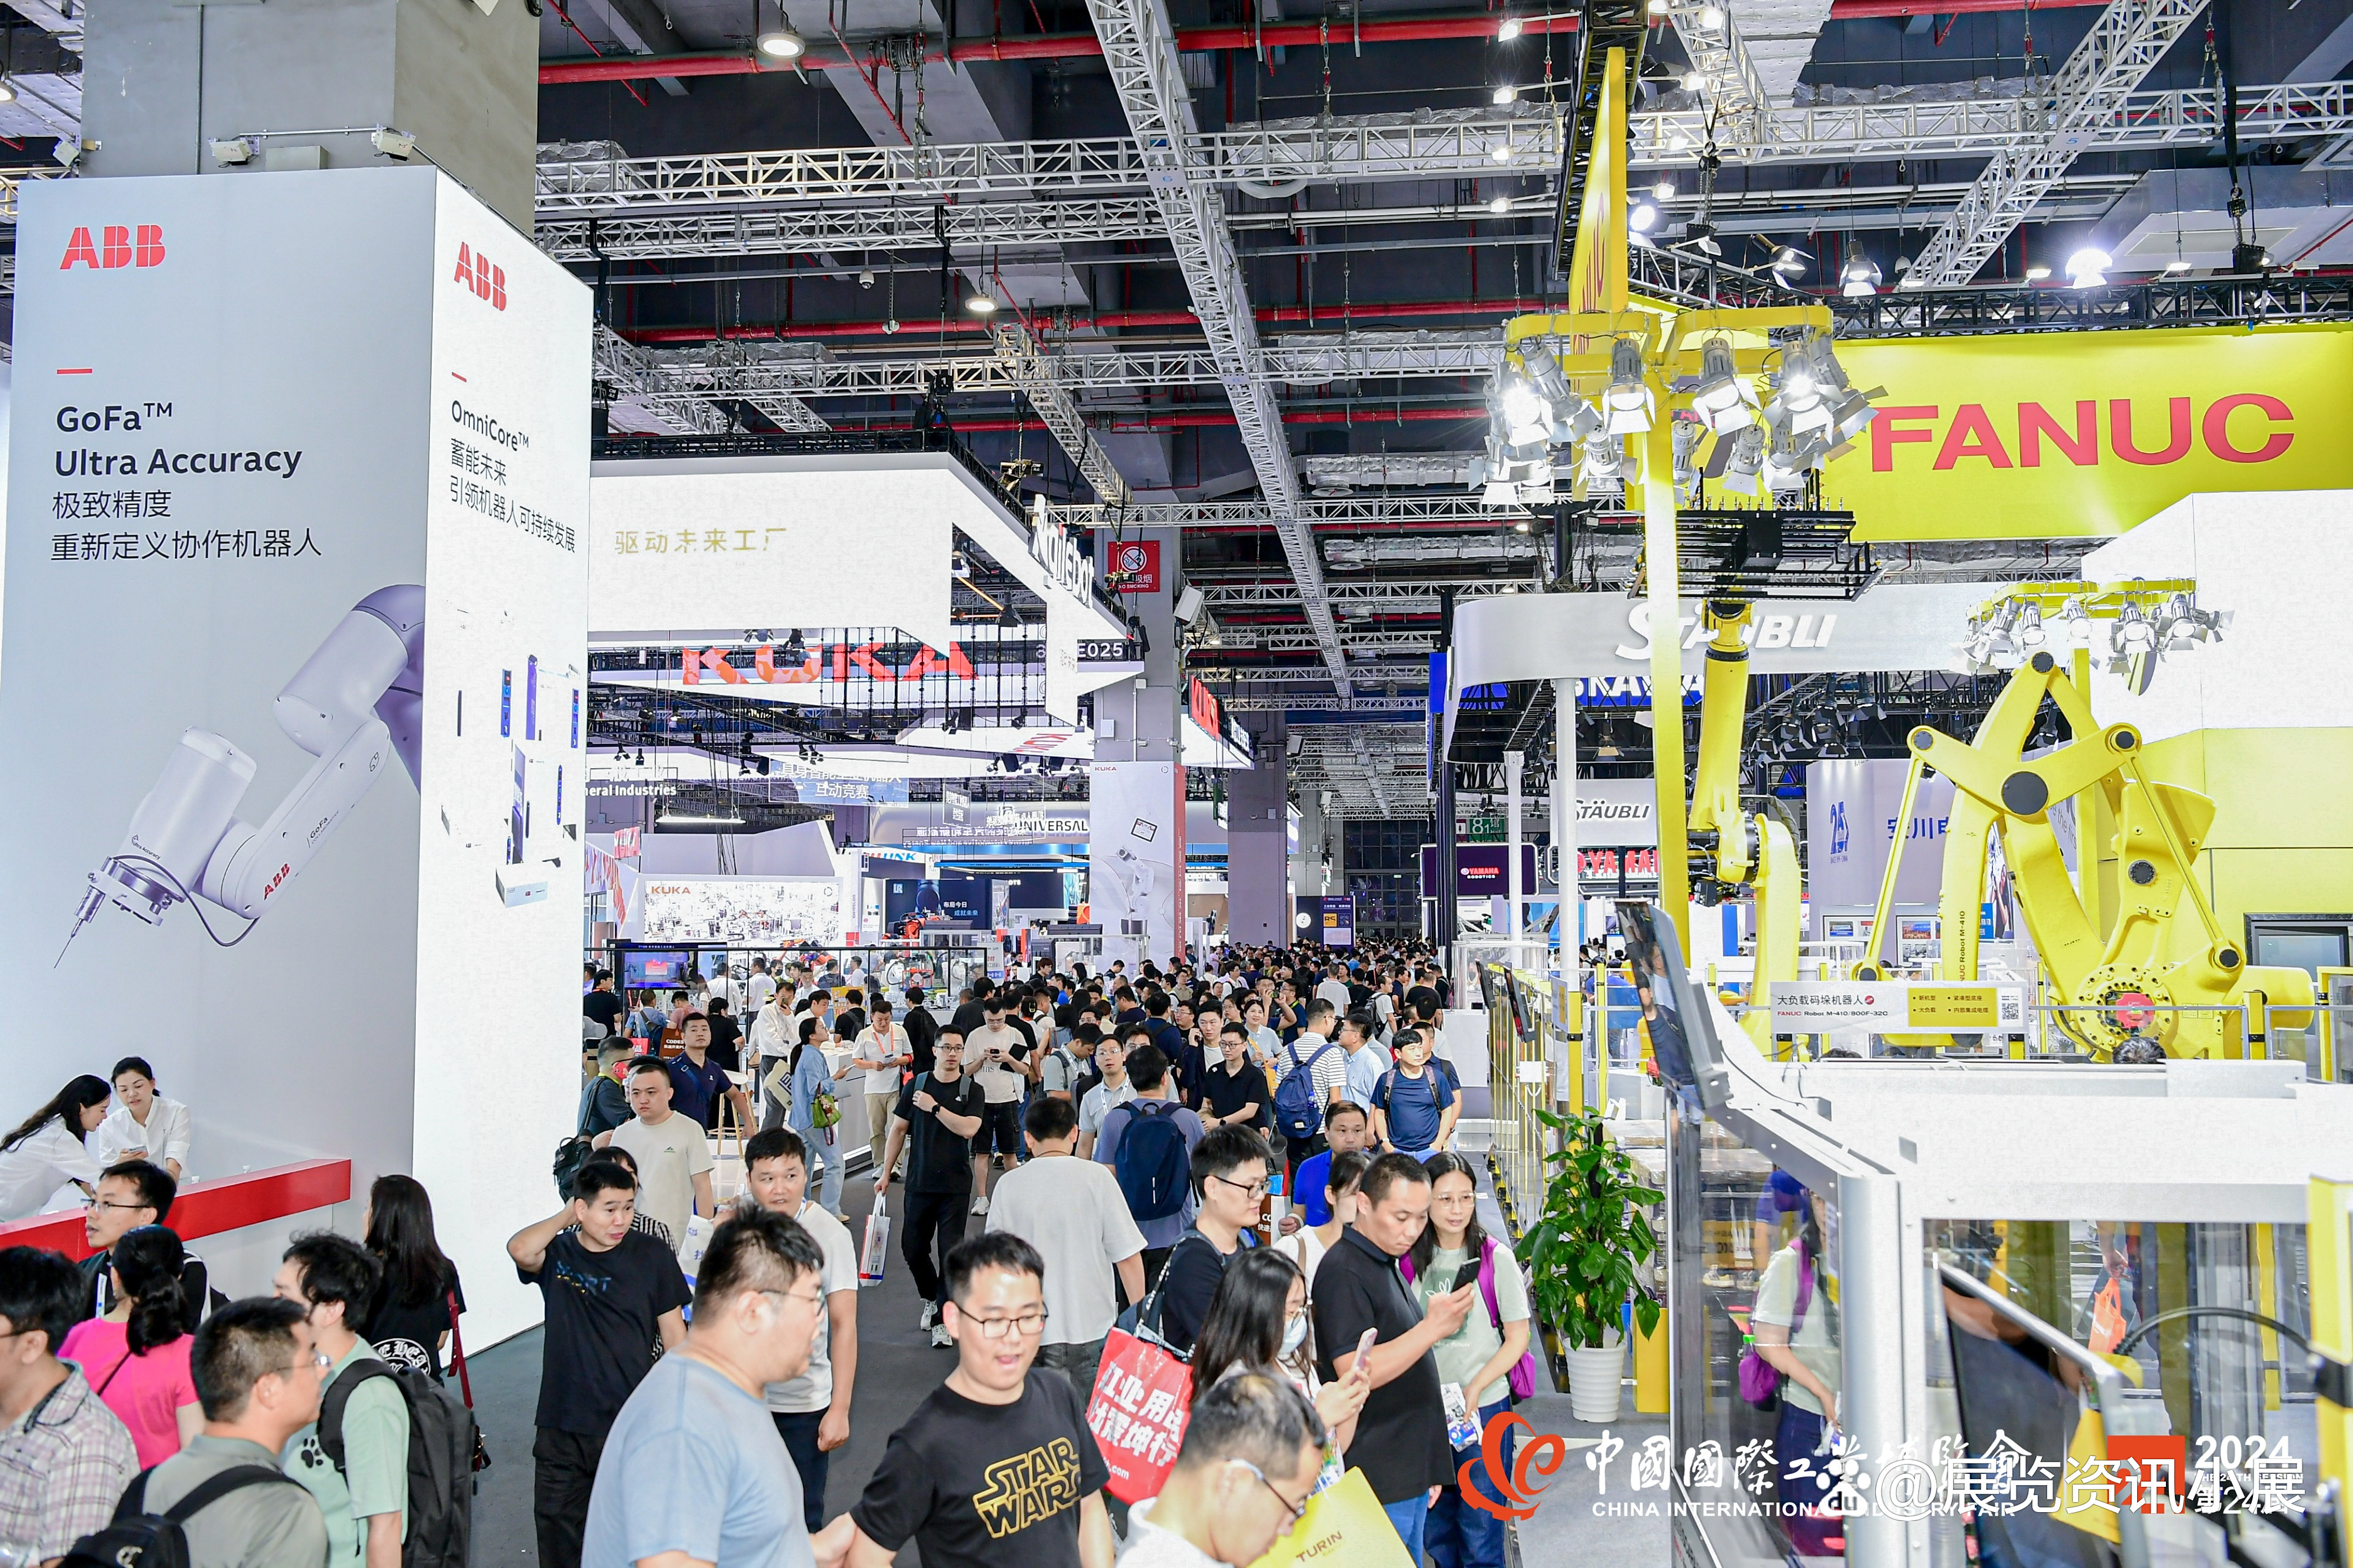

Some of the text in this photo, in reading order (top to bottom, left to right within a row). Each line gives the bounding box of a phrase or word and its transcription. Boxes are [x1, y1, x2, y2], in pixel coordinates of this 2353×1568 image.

[59, 224, 165, 270] ABB
[454, 241, 507, 312] ABB
[1871, 393, 2294, 472] FANUC
[55, 447, 302, 478] Ultra Accuracy
[451, 438, 507, 486] 蓄能未来
[53, 489, 172, 520] 极致精度
[449, 475, 576, 553] 引领机器人可持续发展
[51, 528, 322, 562] 重新定义协作机器人
[615, 528, 787, 554] 驱动未来工厂
[683, 641, 979, 685] KUKA
[615, 783, 676, 796] Industries
[309, 816, 329, 840] GoFa
[2058, 807, 2067, 833] the
[141, 845, 161, 860] Accuracy
[264, 863, 291, 900] ABB
[651, 886, 691, 895] KUKA
[1777, 995, 1864, 1006] 大负载码垛机器人
[972, 1437, 1080, 1506] STAR
[975, 1468, 1082, 1539] WARS
[1296, 1531, 1342, 1562] TURIN
